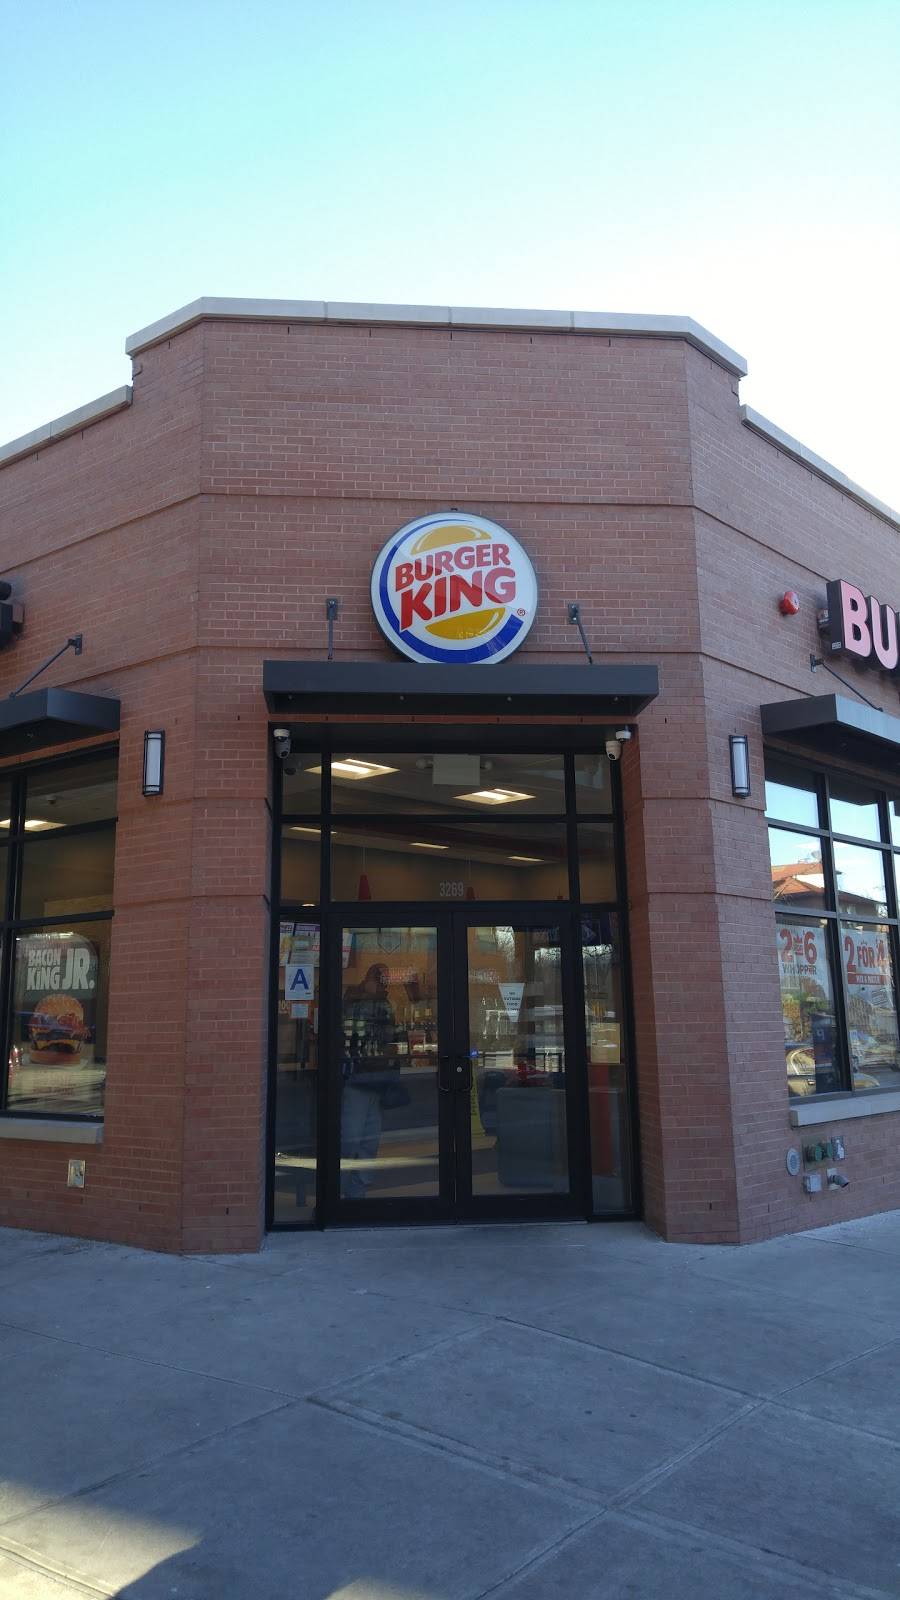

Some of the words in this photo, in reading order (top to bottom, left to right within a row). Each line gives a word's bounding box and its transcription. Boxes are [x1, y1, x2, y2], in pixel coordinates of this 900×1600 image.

[395, 543, 511, 592] BURGER
[401, 567, 516, 631] KING
[440, 882, 464, 897] 3269
[28, 948, 61, 967] BACON
[290, 968, 309, 991] A
